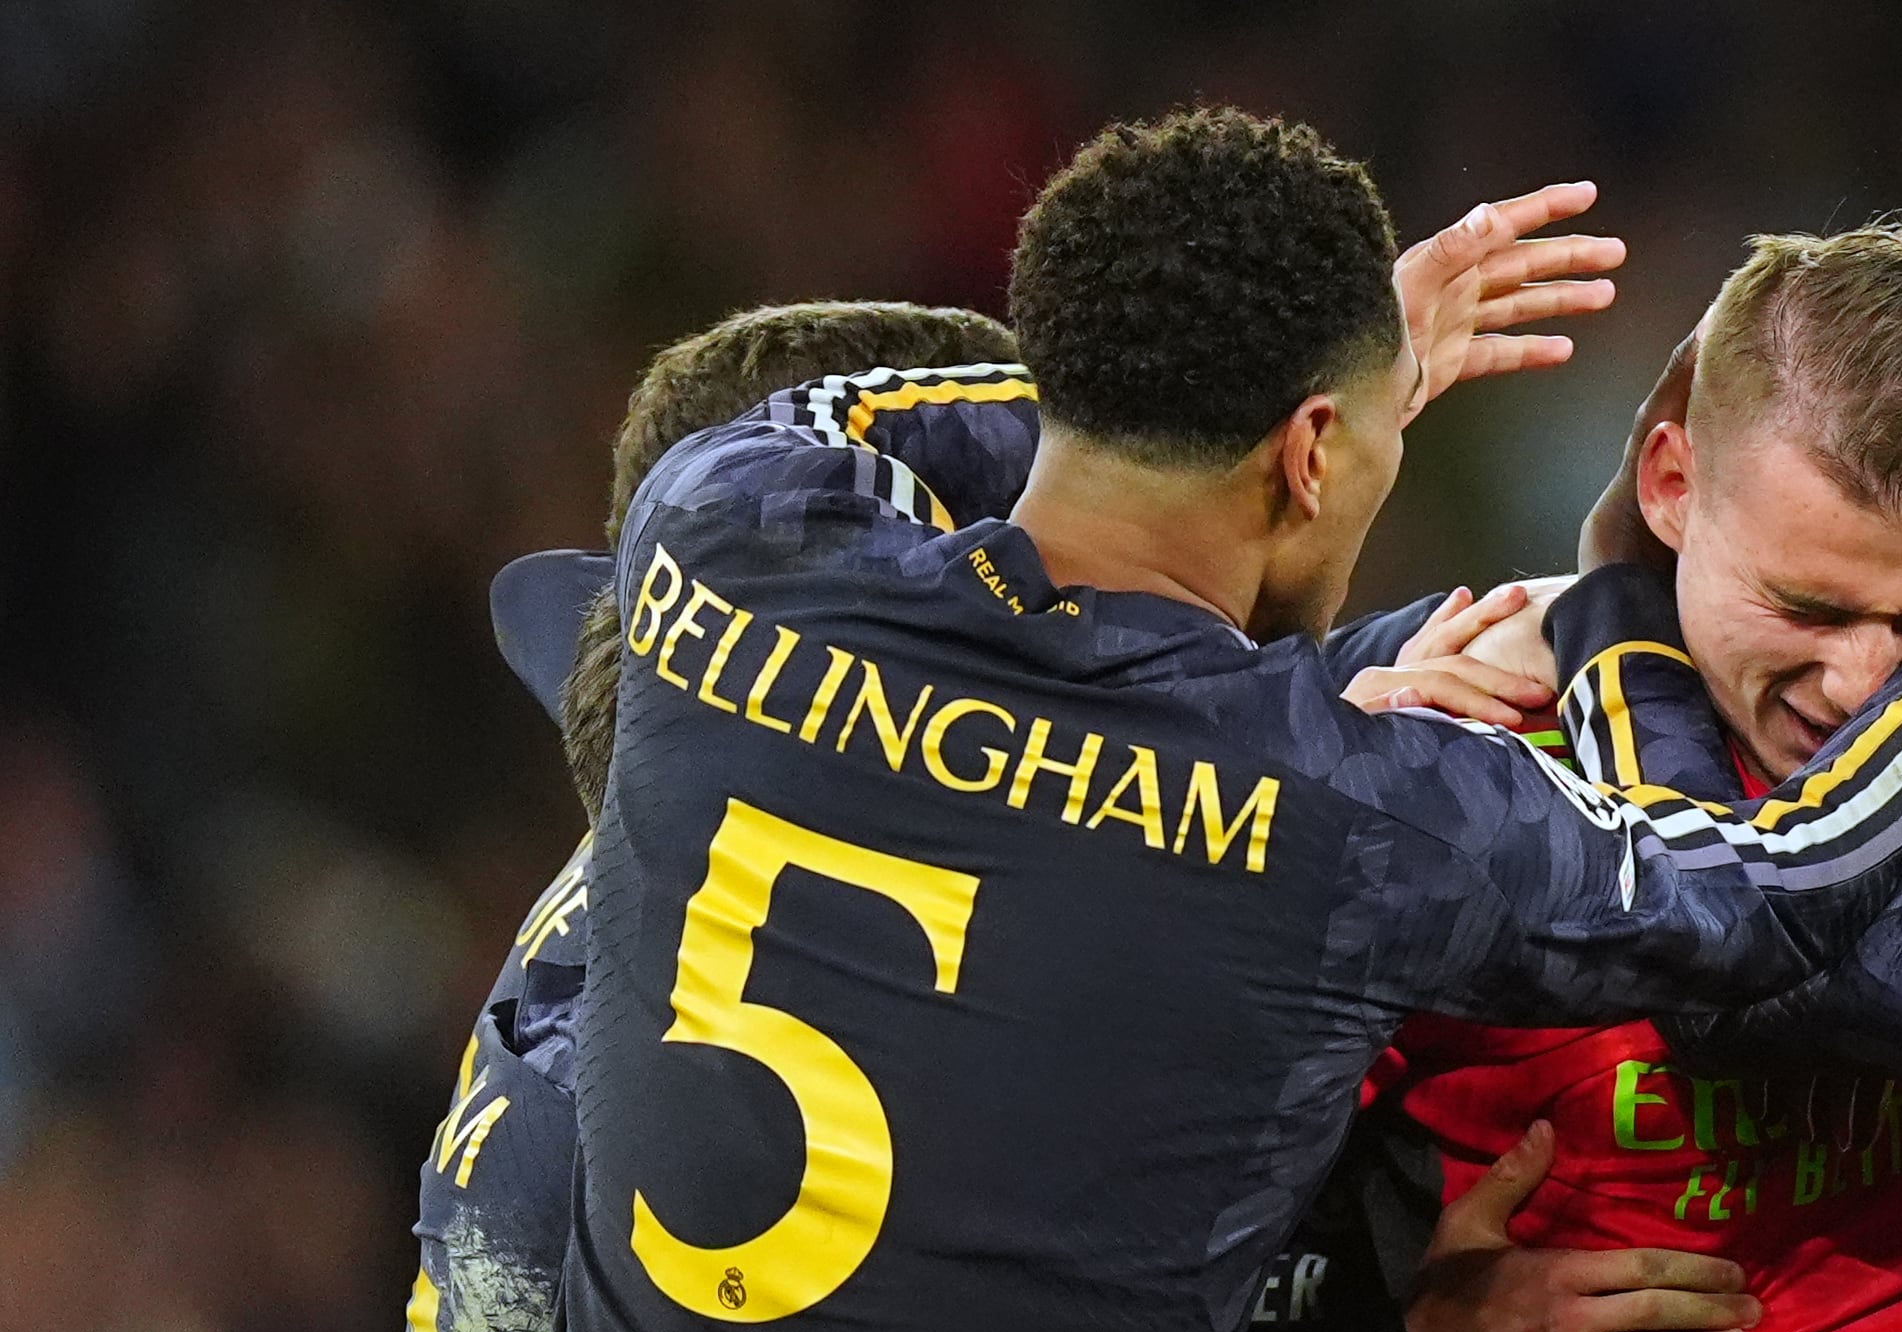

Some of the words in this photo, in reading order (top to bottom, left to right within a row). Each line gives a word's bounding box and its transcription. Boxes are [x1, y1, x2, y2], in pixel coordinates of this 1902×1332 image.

[627, 542, 1280, 873] BELLINGHAM
[968, 547, 1008, 600] REAL
[631, 798, 980, 1324] 5
